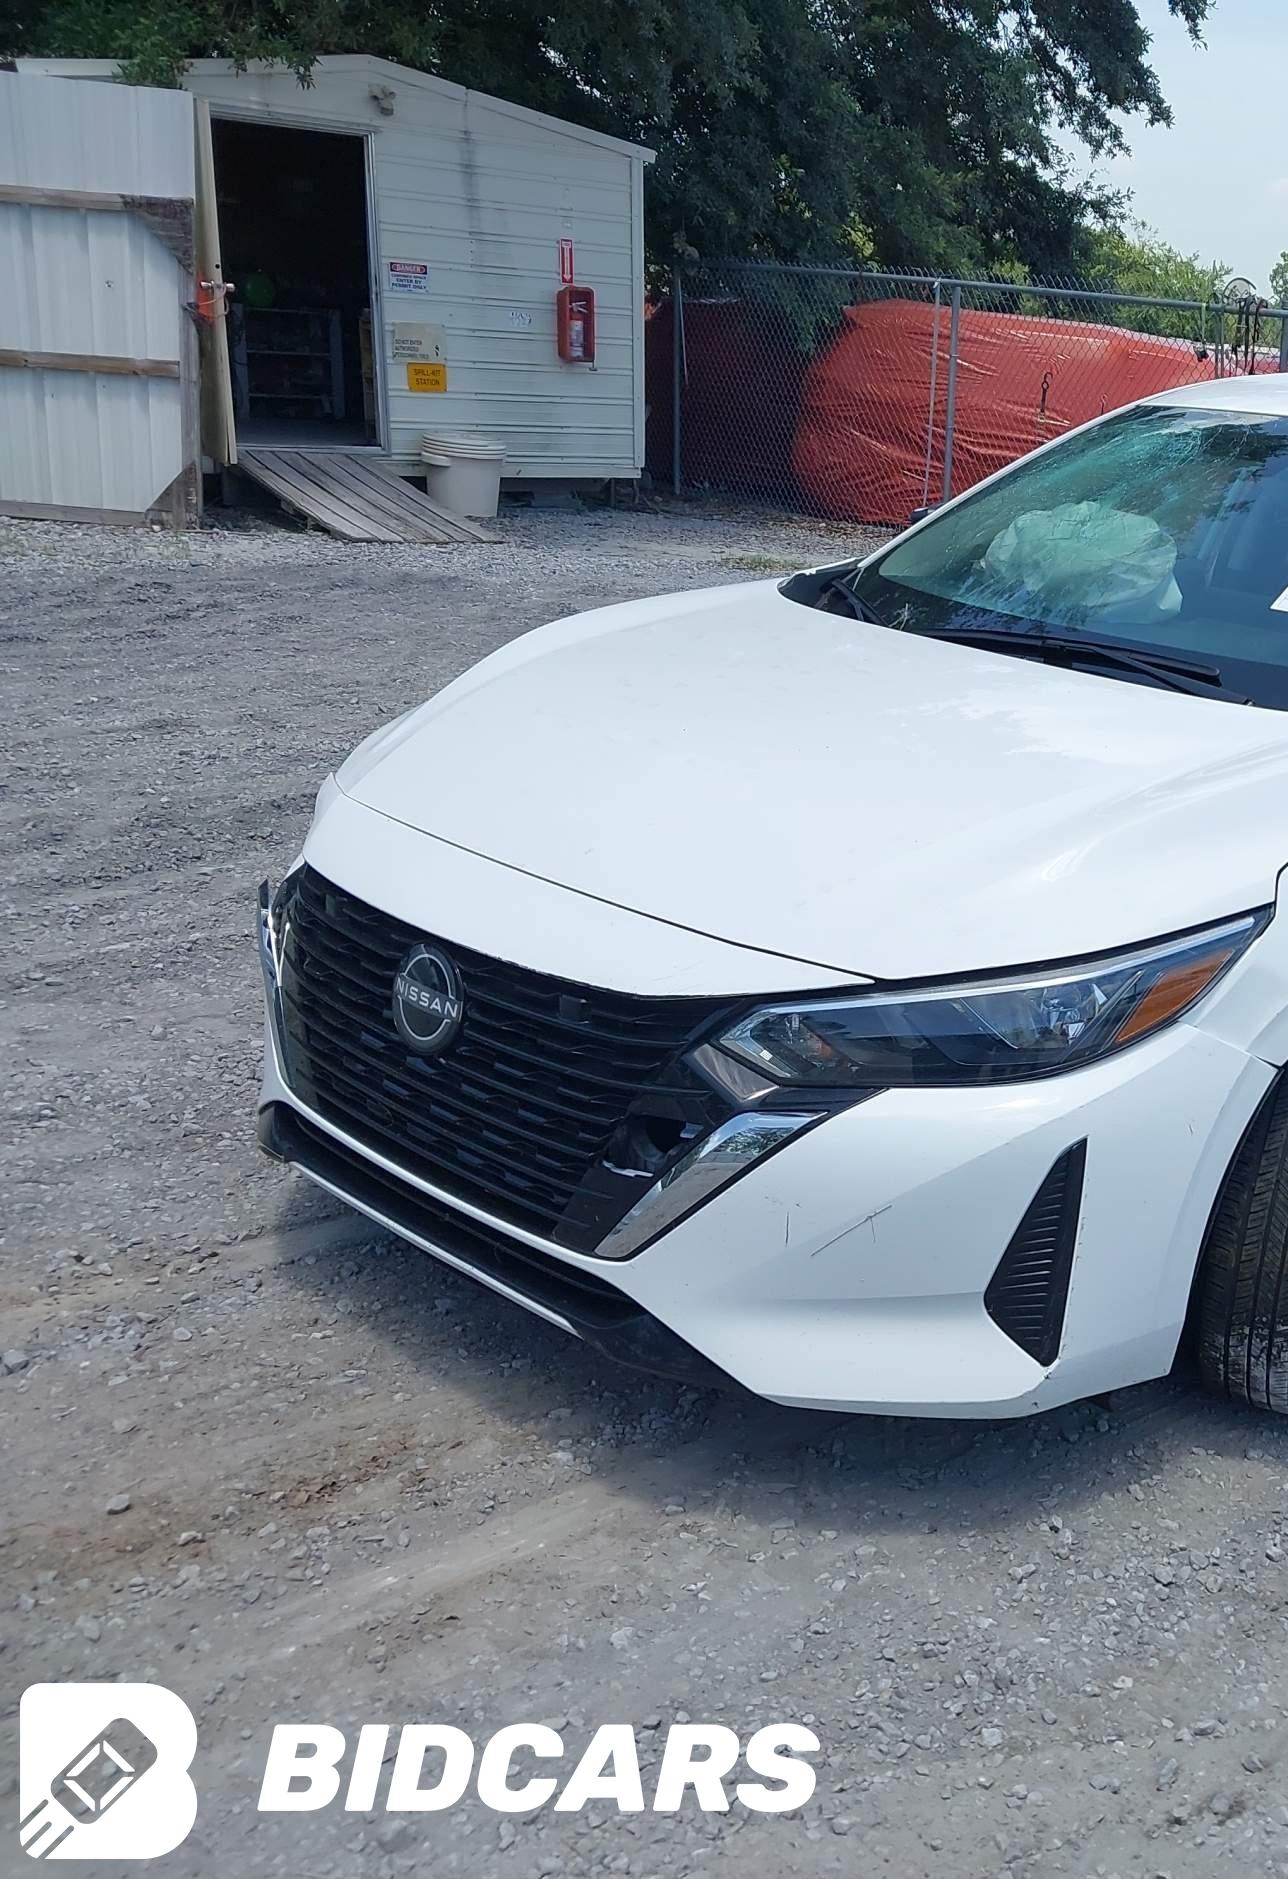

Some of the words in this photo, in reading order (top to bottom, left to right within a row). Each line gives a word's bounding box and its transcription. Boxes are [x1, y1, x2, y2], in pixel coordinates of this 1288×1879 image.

[396, 263, 421, 273] DANGER
[415, 377, 440, 385] STATION
[396, 976, 458, 1018] NISSAN
